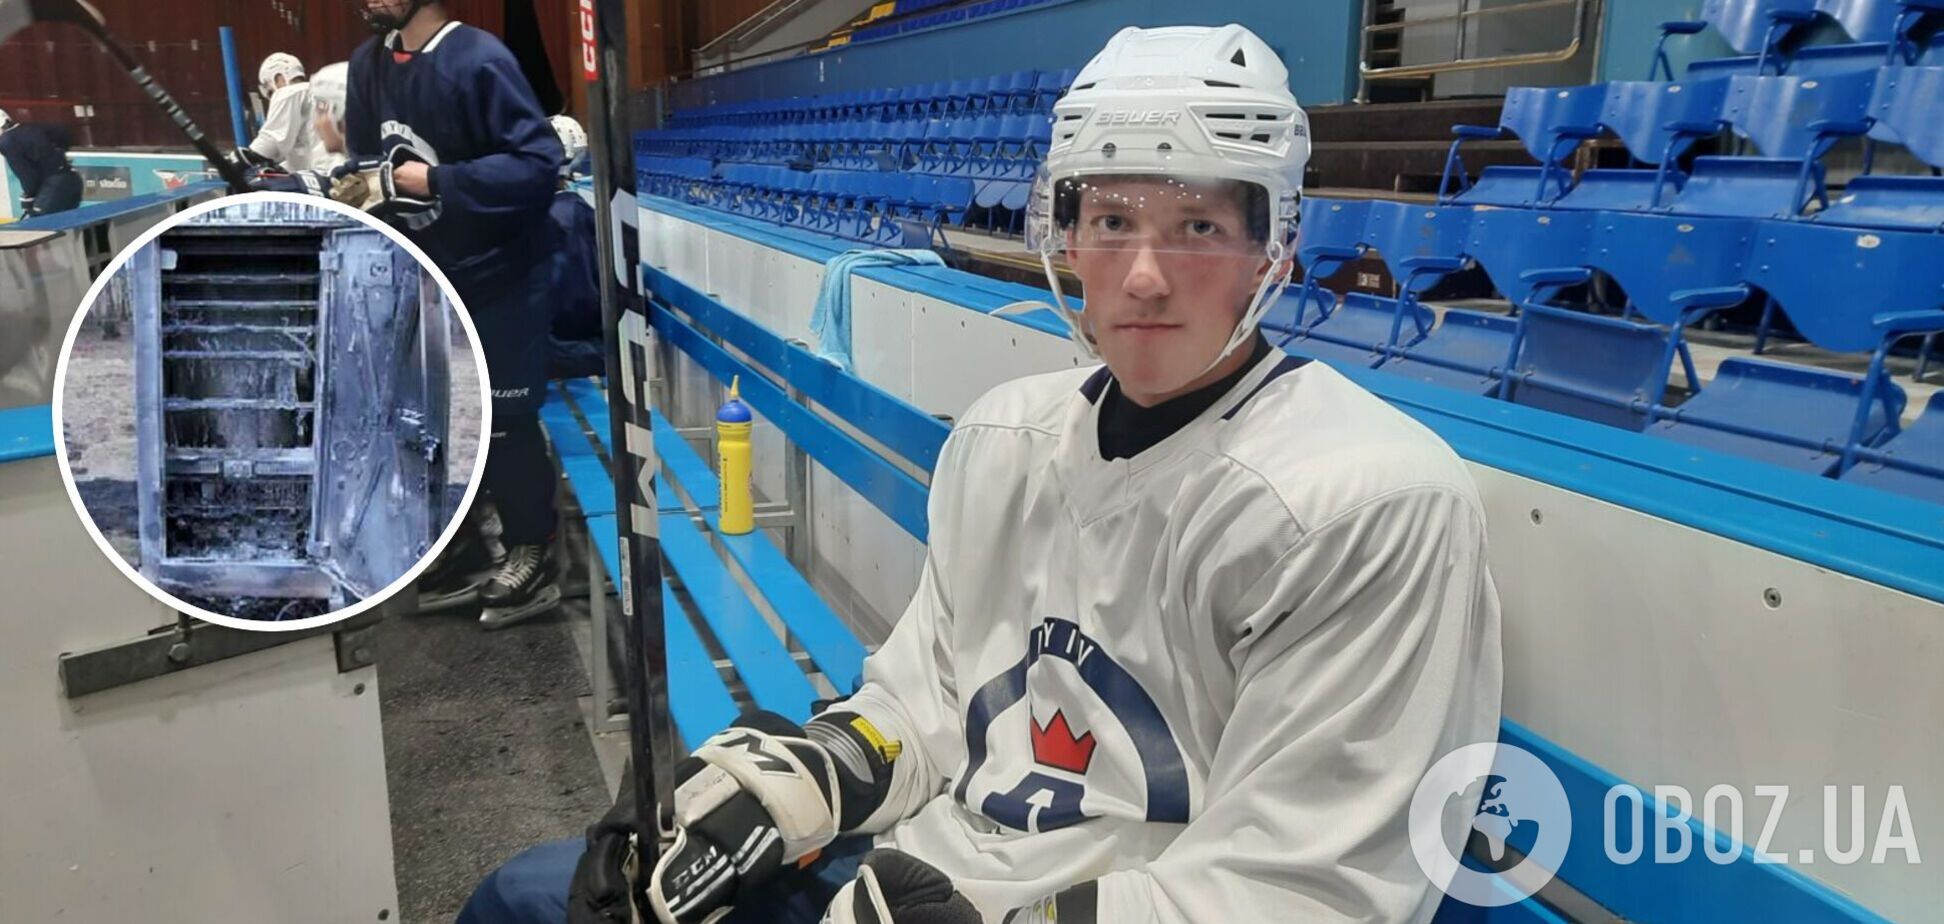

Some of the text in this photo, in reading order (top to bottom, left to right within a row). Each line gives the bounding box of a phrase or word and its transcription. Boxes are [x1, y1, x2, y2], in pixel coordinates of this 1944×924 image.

[1096, 110, 1181, 125] BAUER
[99, 177, 128, 189] studio
[610, 187, 660, 539] CCM
[672, 845, 718, 889] CCM
